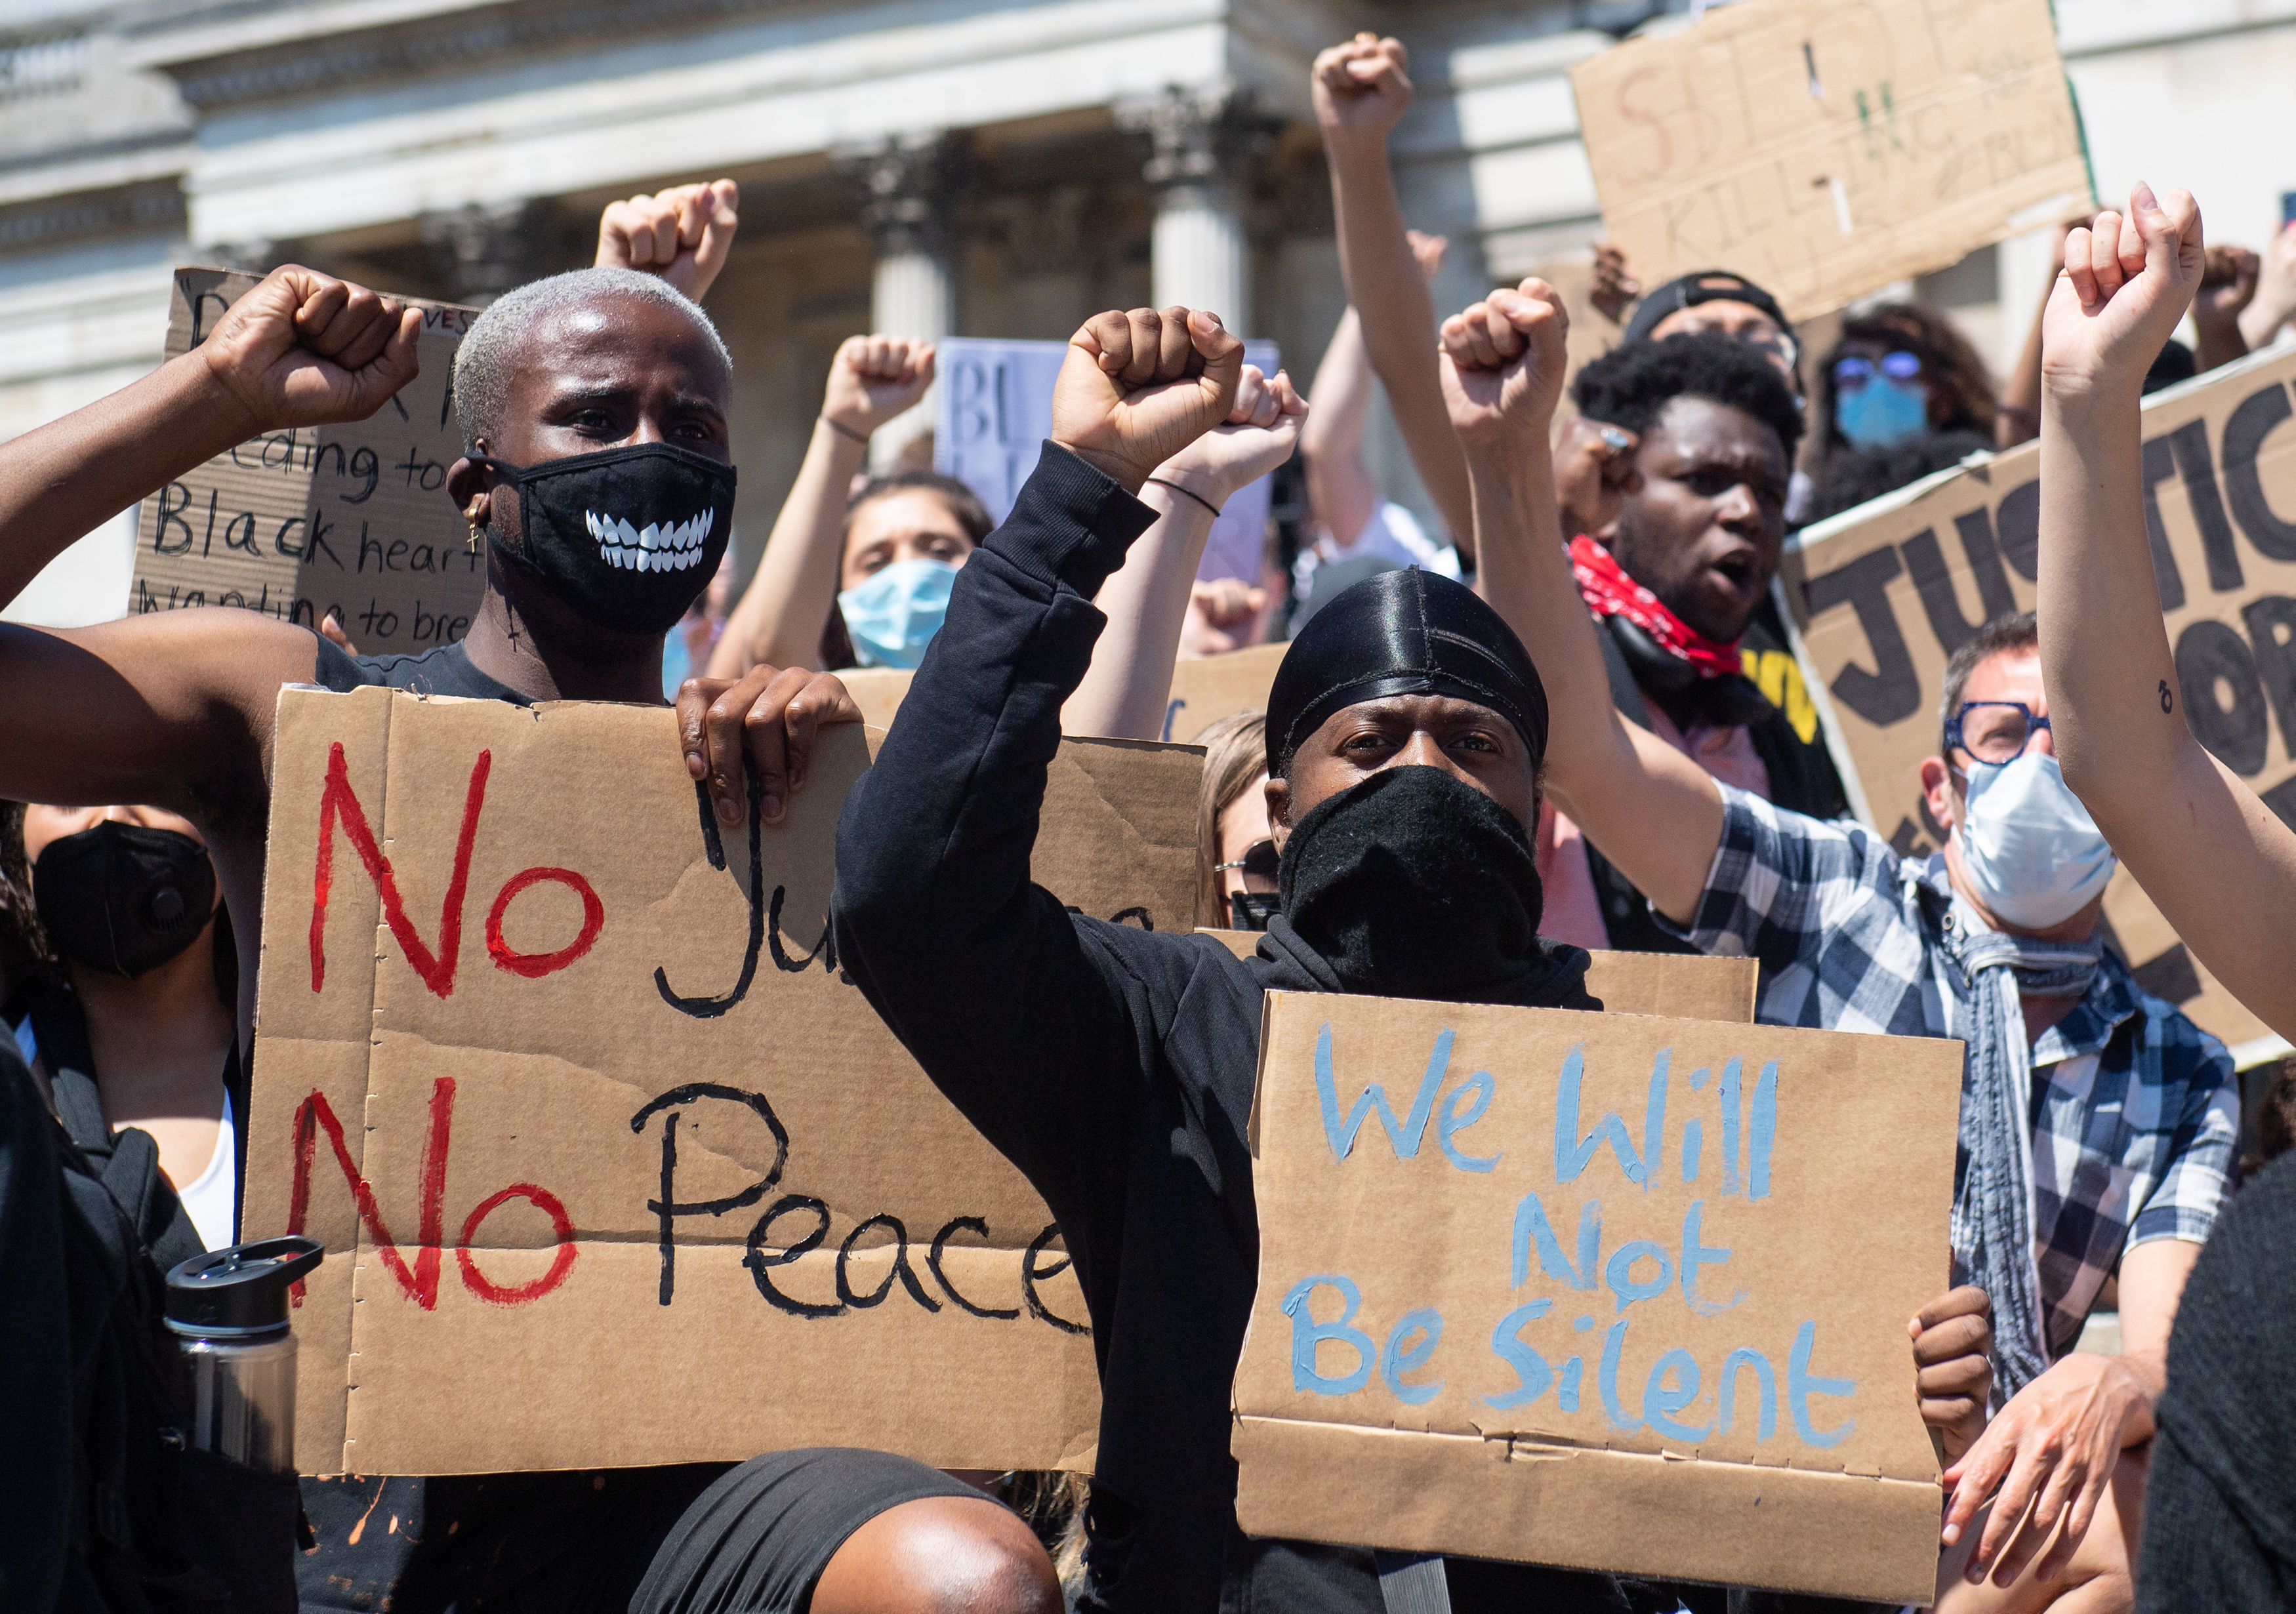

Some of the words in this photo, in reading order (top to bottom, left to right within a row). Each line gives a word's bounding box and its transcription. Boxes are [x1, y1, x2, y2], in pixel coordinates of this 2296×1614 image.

[155, 482, 344, 571] Black
[395, 447, 448, 490] to
[359, 597, 399, 637] to
[308, 741, 605, 1000] No
[1314, 1021, 1504, 1173] We
[1554, 1043, 1781, 1203] Will
[286, 1076, 579, 1312] No
[630, 1081, 1094, 1336] Peace
[1511, 1192, 1750, 1317] Not
[1281, 1274, 1445, 1405] Be
[1479, 1297, 1858, 1449] Silent
